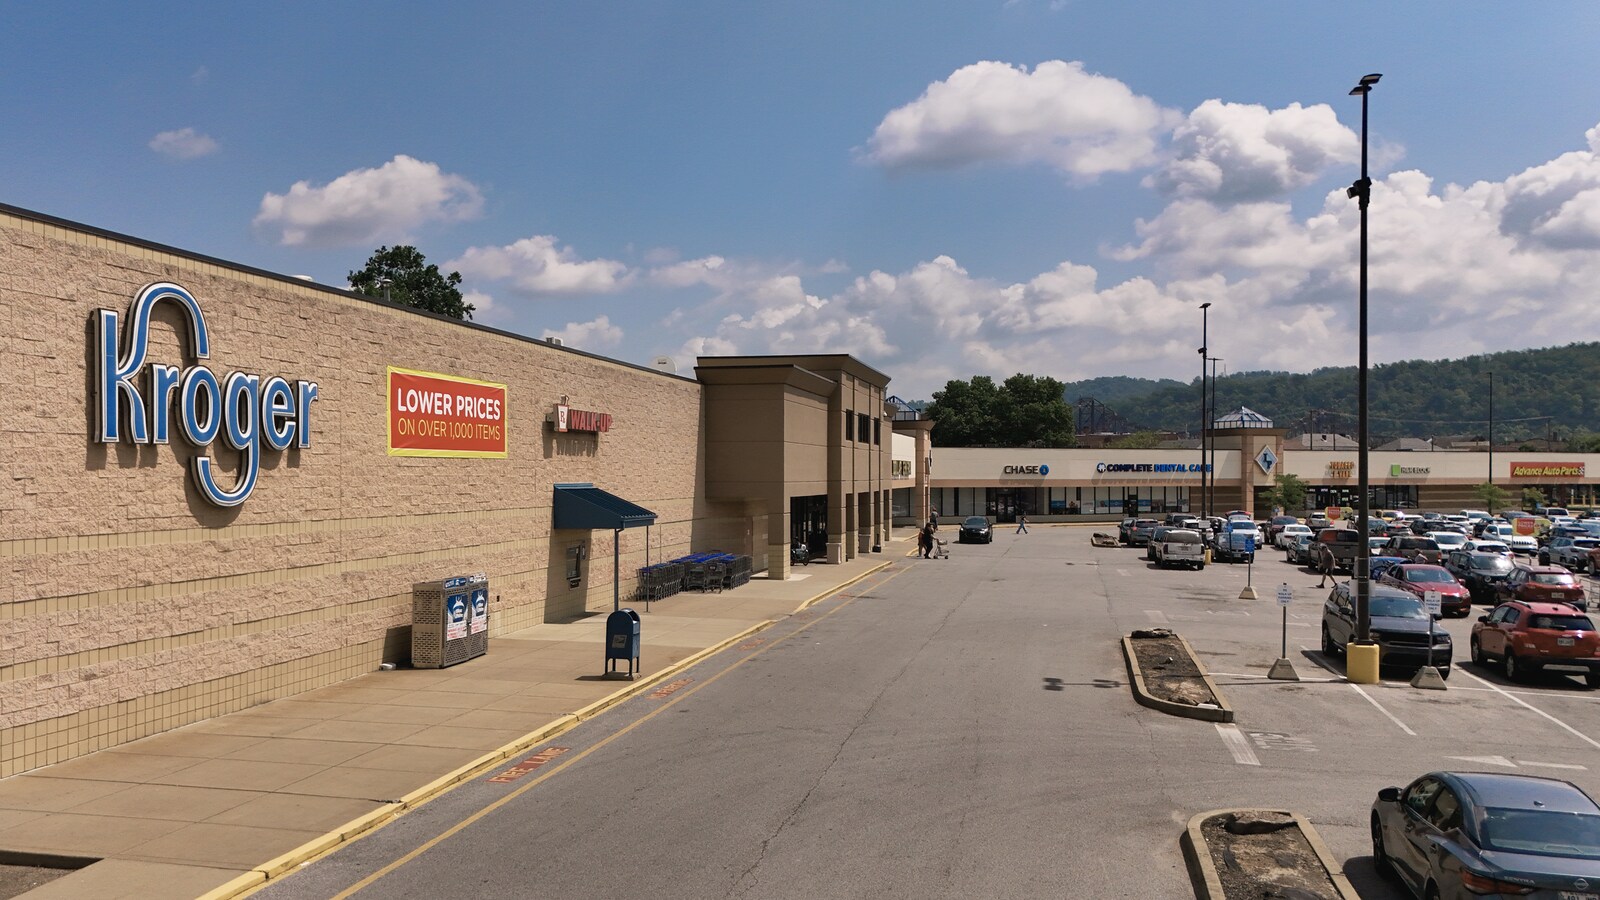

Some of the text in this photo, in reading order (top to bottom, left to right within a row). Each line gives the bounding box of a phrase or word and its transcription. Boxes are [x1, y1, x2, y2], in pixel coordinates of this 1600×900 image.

[97, 281, 318, 507] Kroger
[397, 387, 501, 420] LOWER PRICES
[397, 417, 501, 441] ON OVER 1,000 ITEMS
[571, 409, 613, 432] WALK-UP
[1004, 465, 1039, 475] CHASE
[1107, 464, 1153, 472] COMPLETE
[1154, 464, 1188, 473] DENTAL
[1513, 466, 1579, 476] Advance Auto Parts
[487, 747, 570, 783] FIRE LANE
